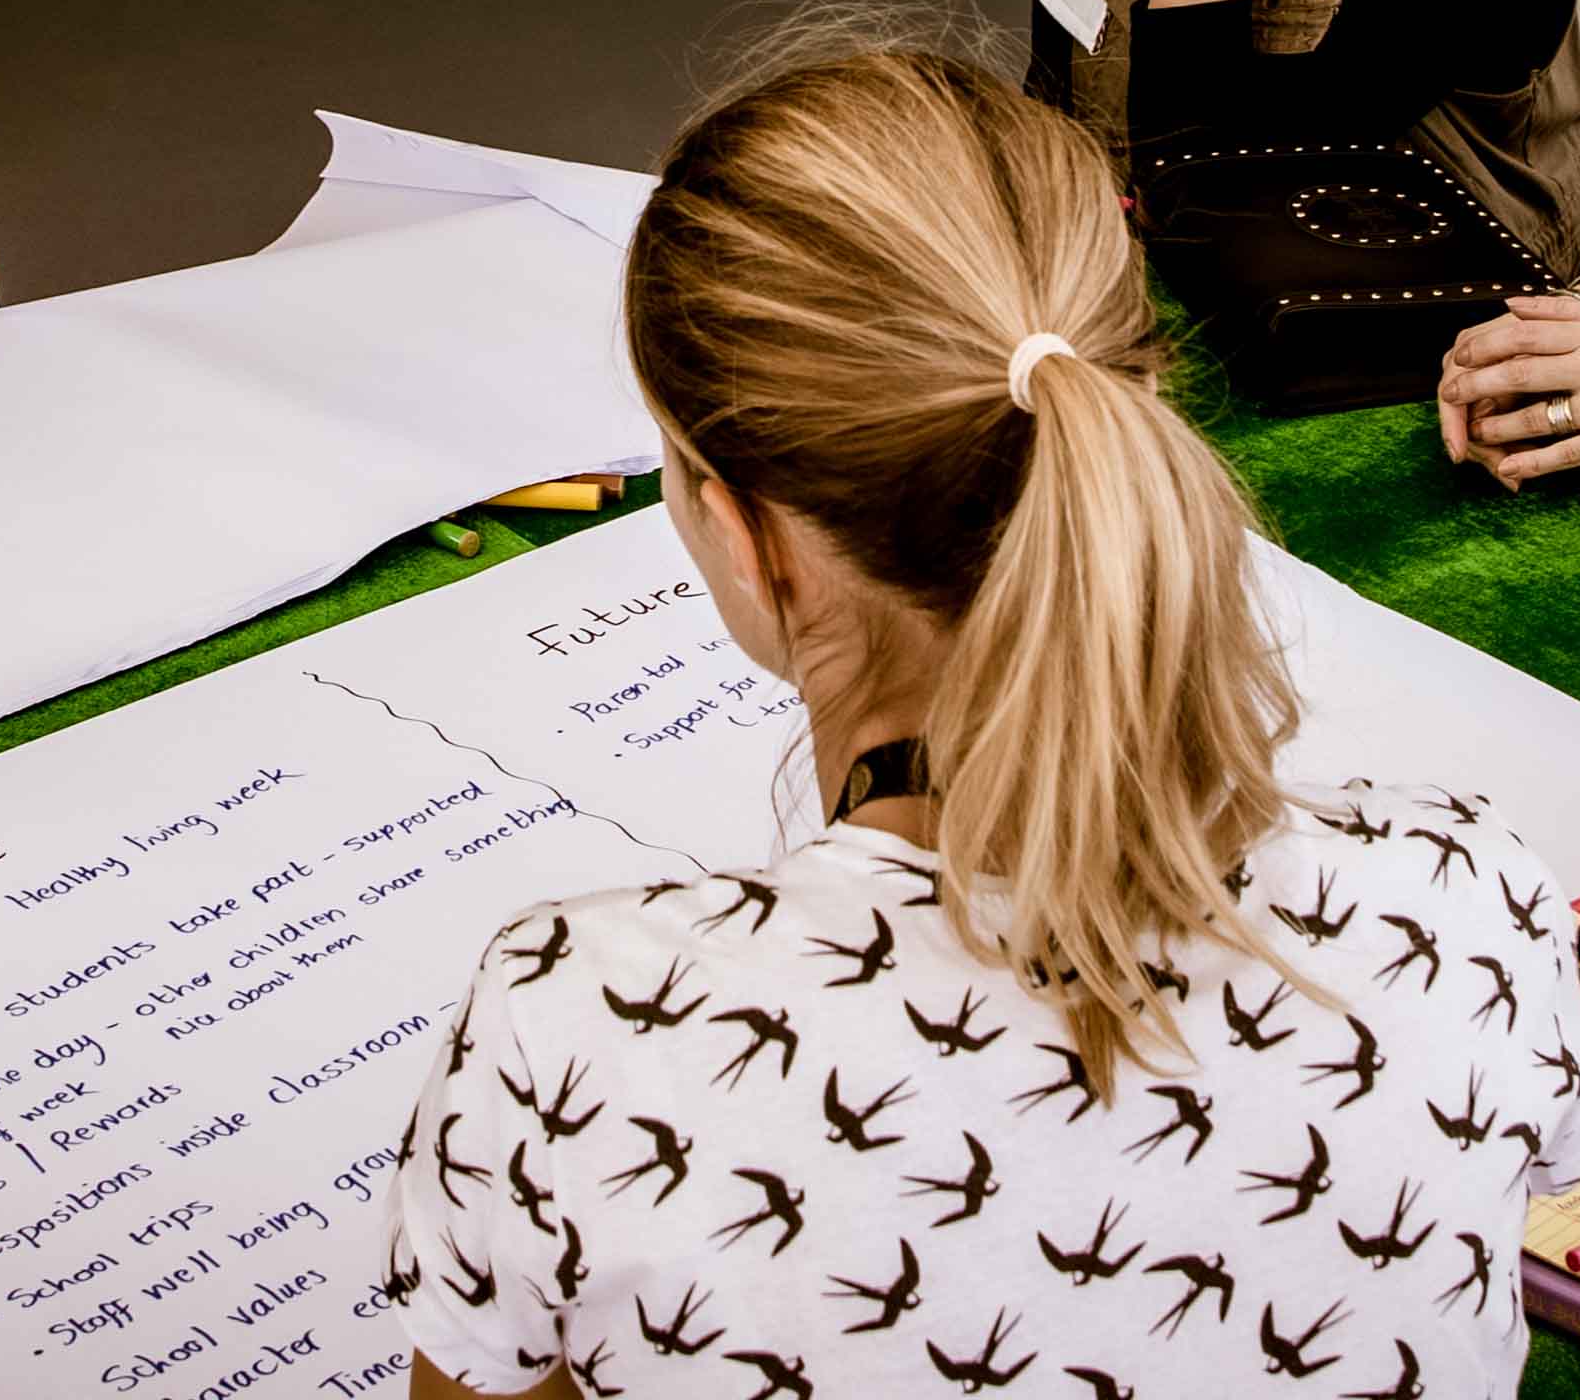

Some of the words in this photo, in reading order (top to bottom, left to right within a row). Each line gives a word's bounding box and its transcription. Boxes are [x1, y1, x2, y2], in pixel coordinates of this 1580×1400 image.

[526, 581, 707, 656] Future
[569, 654, 685, 723] Parental
[623, 698, 720, 749] Support
[718, 676, 759, 701] for
[4, 856, 130, 910] Healthy
[123, 814, 219, 852] living
[215, 768, 307, 810] week
[4, 940, 157, 1018] students
[168, 897, 242, 935] take
[251, 861, 314, 904] part
[342, 780, 495, 853] supported
[33, 1033, 107, 1069] day
[134, 970, 214, 1018] other
[228, 907, 347, 970] children
[357, 866, 427, 906] share
[444, 798, 578, 863] something
[226, 970, 296, 1012] about
[291, 931, 365, 968] them
[19, 1080, 103, 1123] week
[49, 1081, 184, 1153] Rewards
[160, 1111, 251, 1158] inside
[267, 1014, 431, 1104] classroom
[6, 1253, 121, 1309] School
[128, 1199, 215, 1246] trips
[47, 1298, 136, 1347] Staff
[141, 1249, 222, 1300] well
[227, 1200, 330, 1251] being
[333, 1146, 400, 1203] grou
[100, 1326, 219, 1393] School
[226, 1268, 328, 1327] values
[162, 1327, 321, 1400] aracter
[317, 1351, 413, 1400] Time
